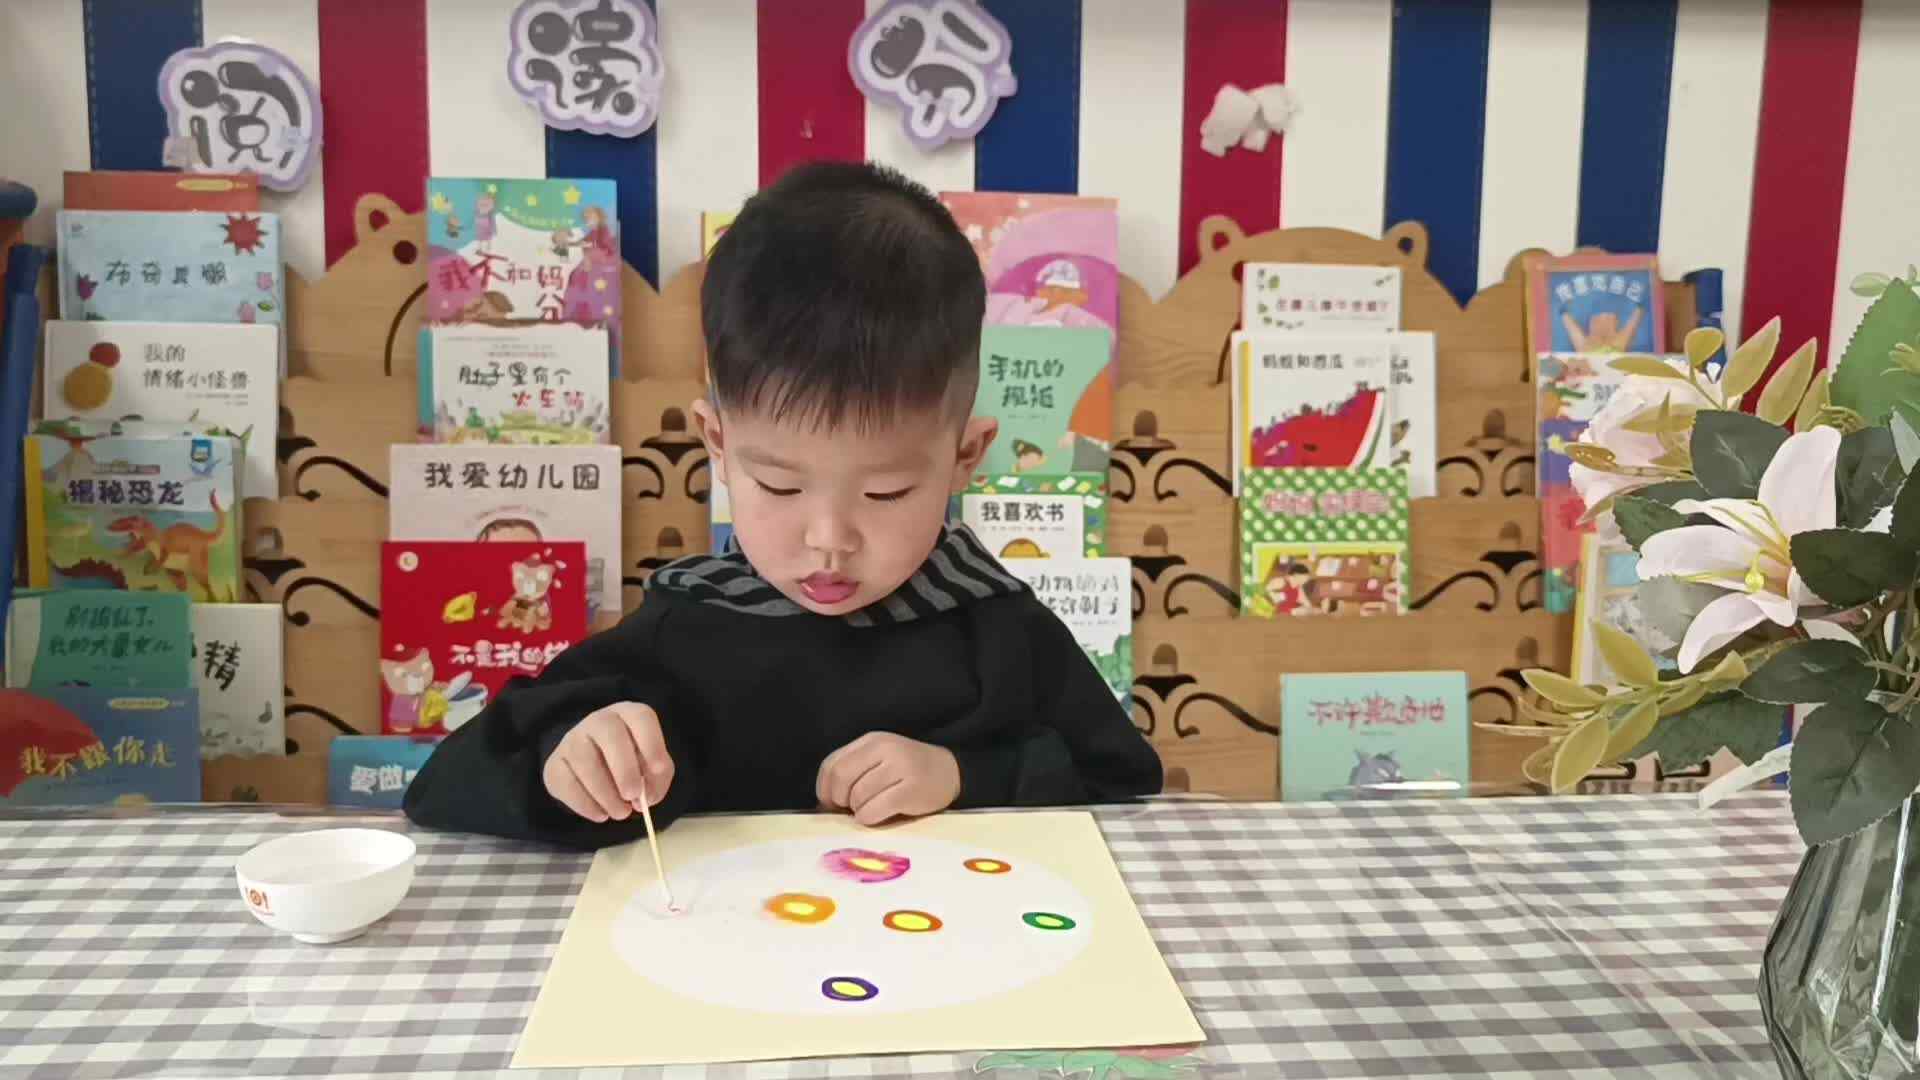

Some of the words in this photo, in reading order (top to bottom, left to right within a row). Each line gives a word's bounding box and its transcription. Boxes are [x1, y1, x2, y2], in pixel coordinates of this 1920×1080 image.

[143, 343, 186, 363] 我的
[143, 370, 250, 390] 情绪小怪兽
[424, 462, 601, 490] 我爱幼儿园
[68, 479, 184, 505] 揭秘恐龙
[981, 501, 1065, 522] 我喜欢书
[191, 640, 242, 690] 精
